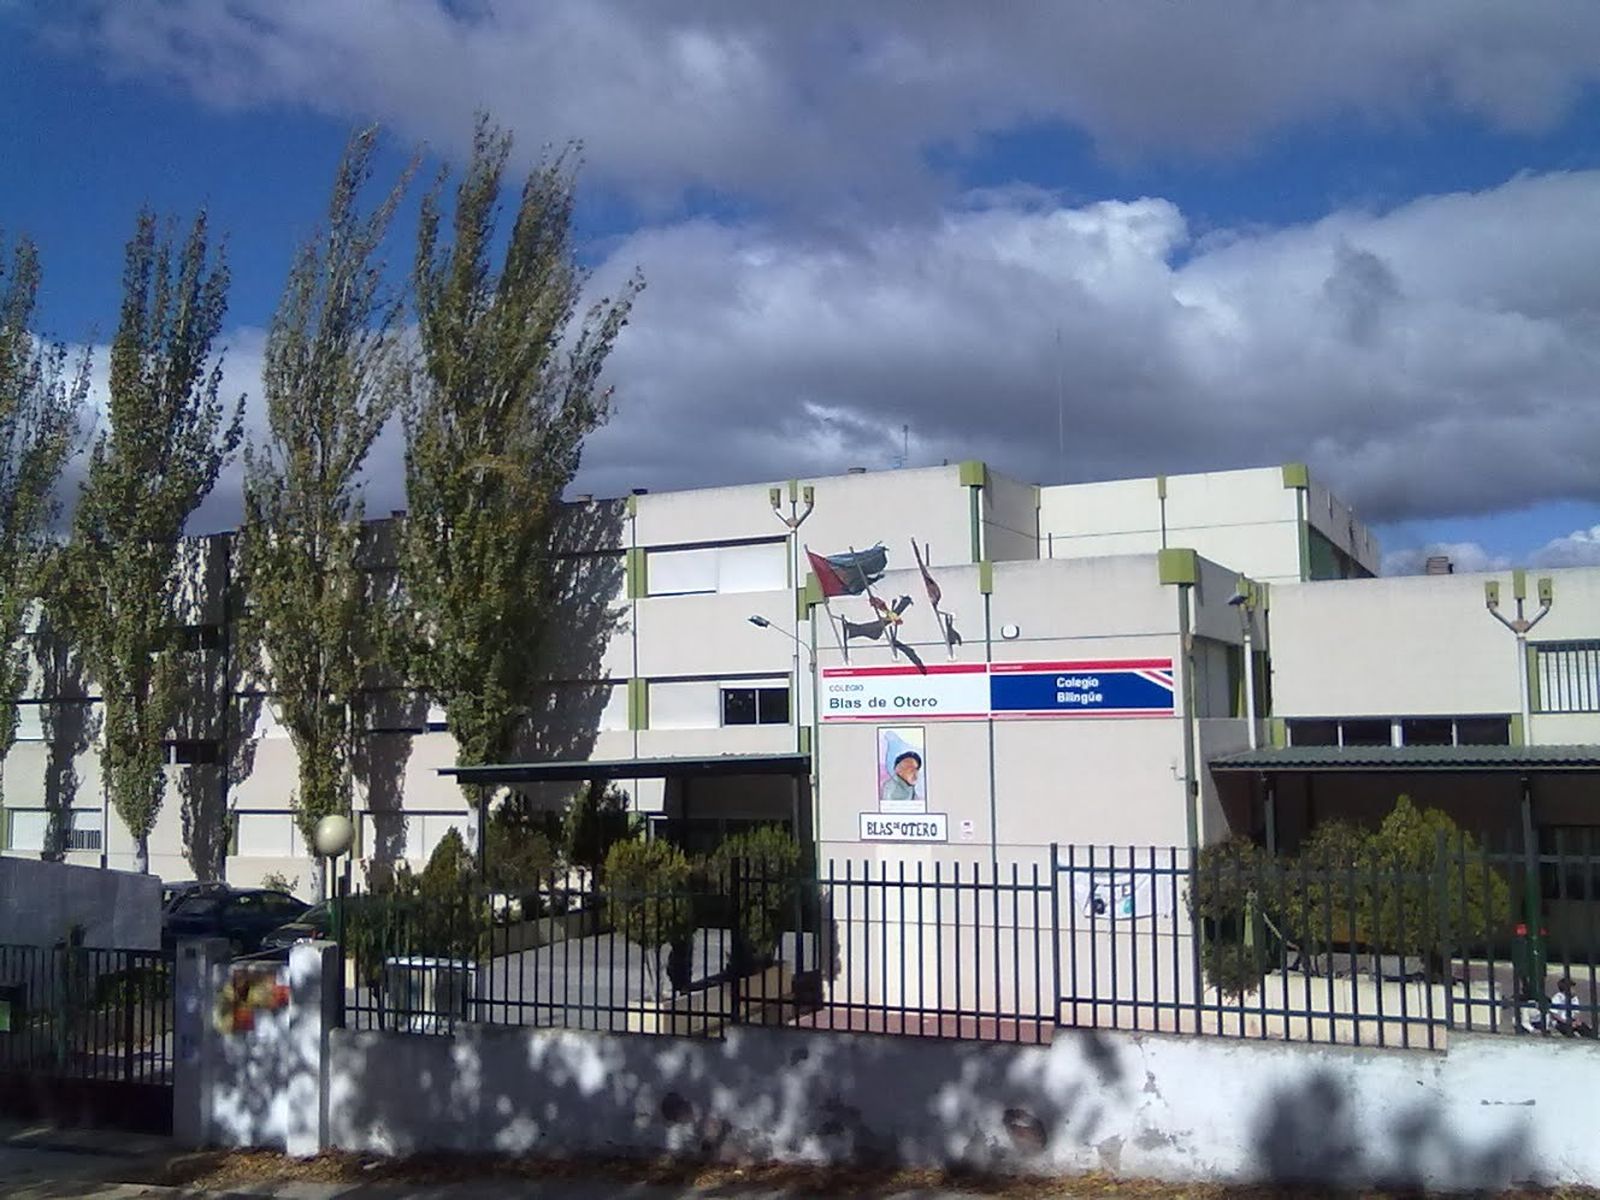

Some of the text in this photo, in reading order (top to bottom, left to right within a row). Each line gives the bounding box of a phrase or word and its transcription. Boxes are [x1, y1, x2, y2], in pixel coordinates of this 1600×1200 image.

[829, 684, 864, 692] COLEGIO
[1056, 676, 1099, 690] Colegio
[829, 695, 938, 709] Blas de Otero
[1057, 691, 1103, 705] Bilingüe
[866, 821, 893, 836] BLAS
[901, 822, 938, 837] OTERO
